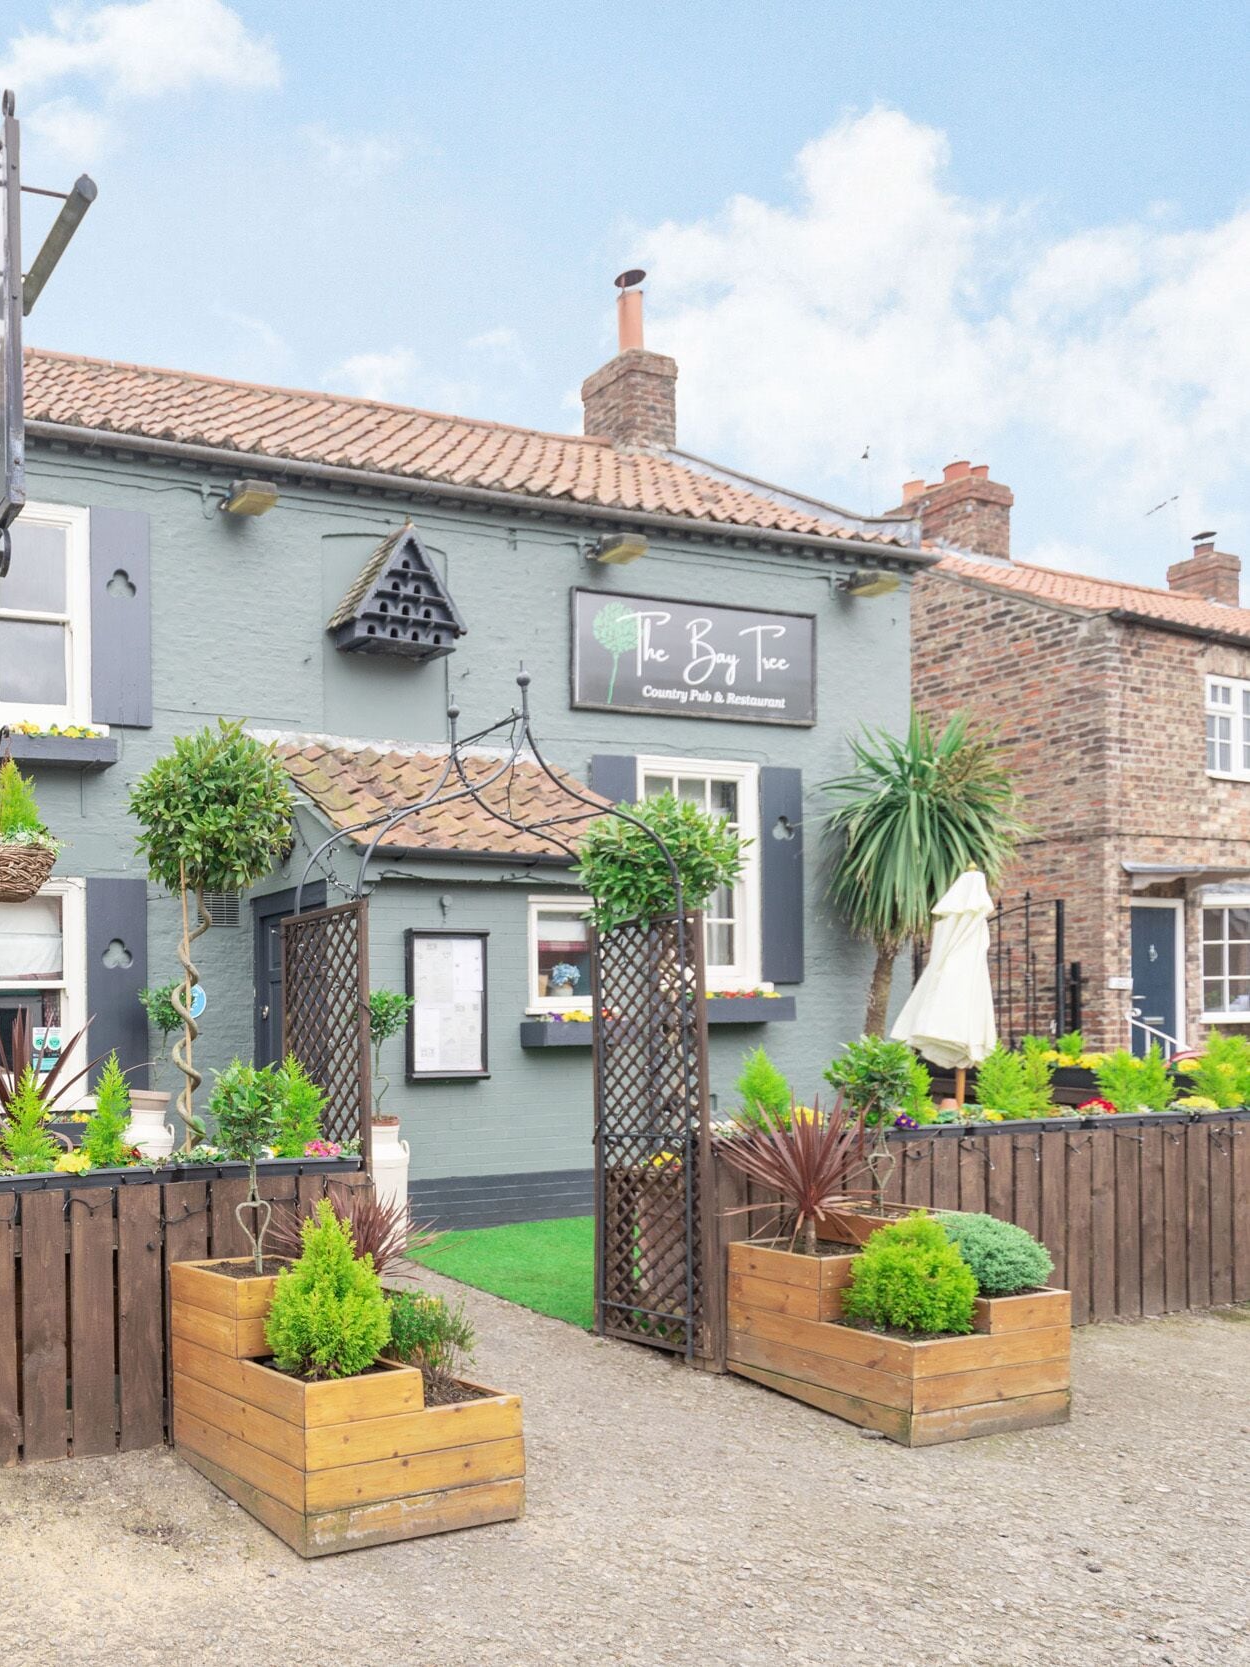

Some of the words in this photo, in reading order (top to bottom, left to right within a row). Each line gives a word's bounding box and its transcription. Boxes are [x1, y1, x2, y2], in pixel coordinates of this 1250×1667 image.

[616, 612, 671, 677] The
[683, 618, 740, 685] Bay
[738, 625, 790, 682] Tree
[642, 685, 688, 704] Country
[689, 689, 712, 702] Pub
[714, 692, 725, 704] &
[726, 692, 786, 709] Restaurant
